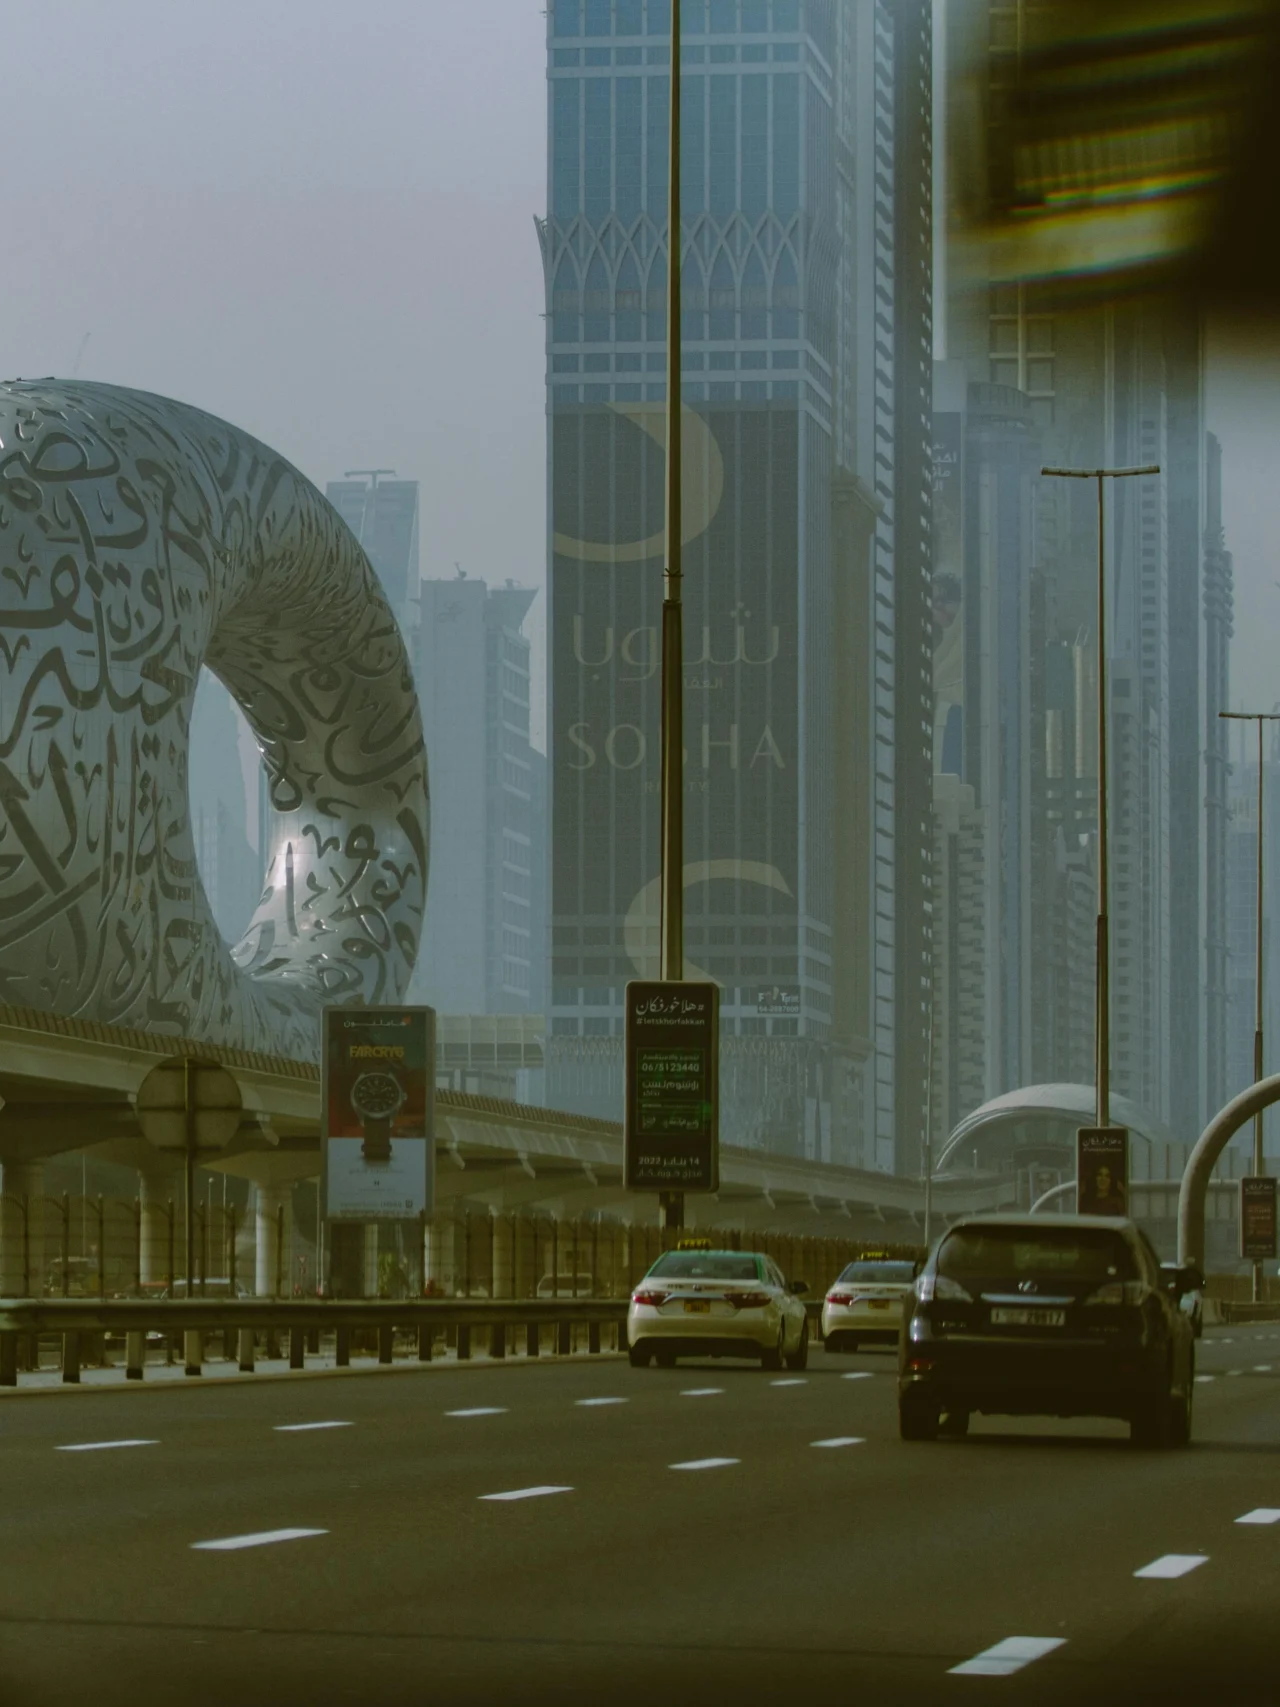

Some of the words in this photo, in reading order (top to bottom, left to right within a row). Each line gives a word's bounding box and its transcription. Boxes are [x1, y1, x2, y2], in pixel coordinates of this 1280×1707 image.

[636, 1017, 705, 1025] #letskhorfakkan
[638, 1156, 661, 1165] 2022
[689, 1156, 700, 1165] 14
